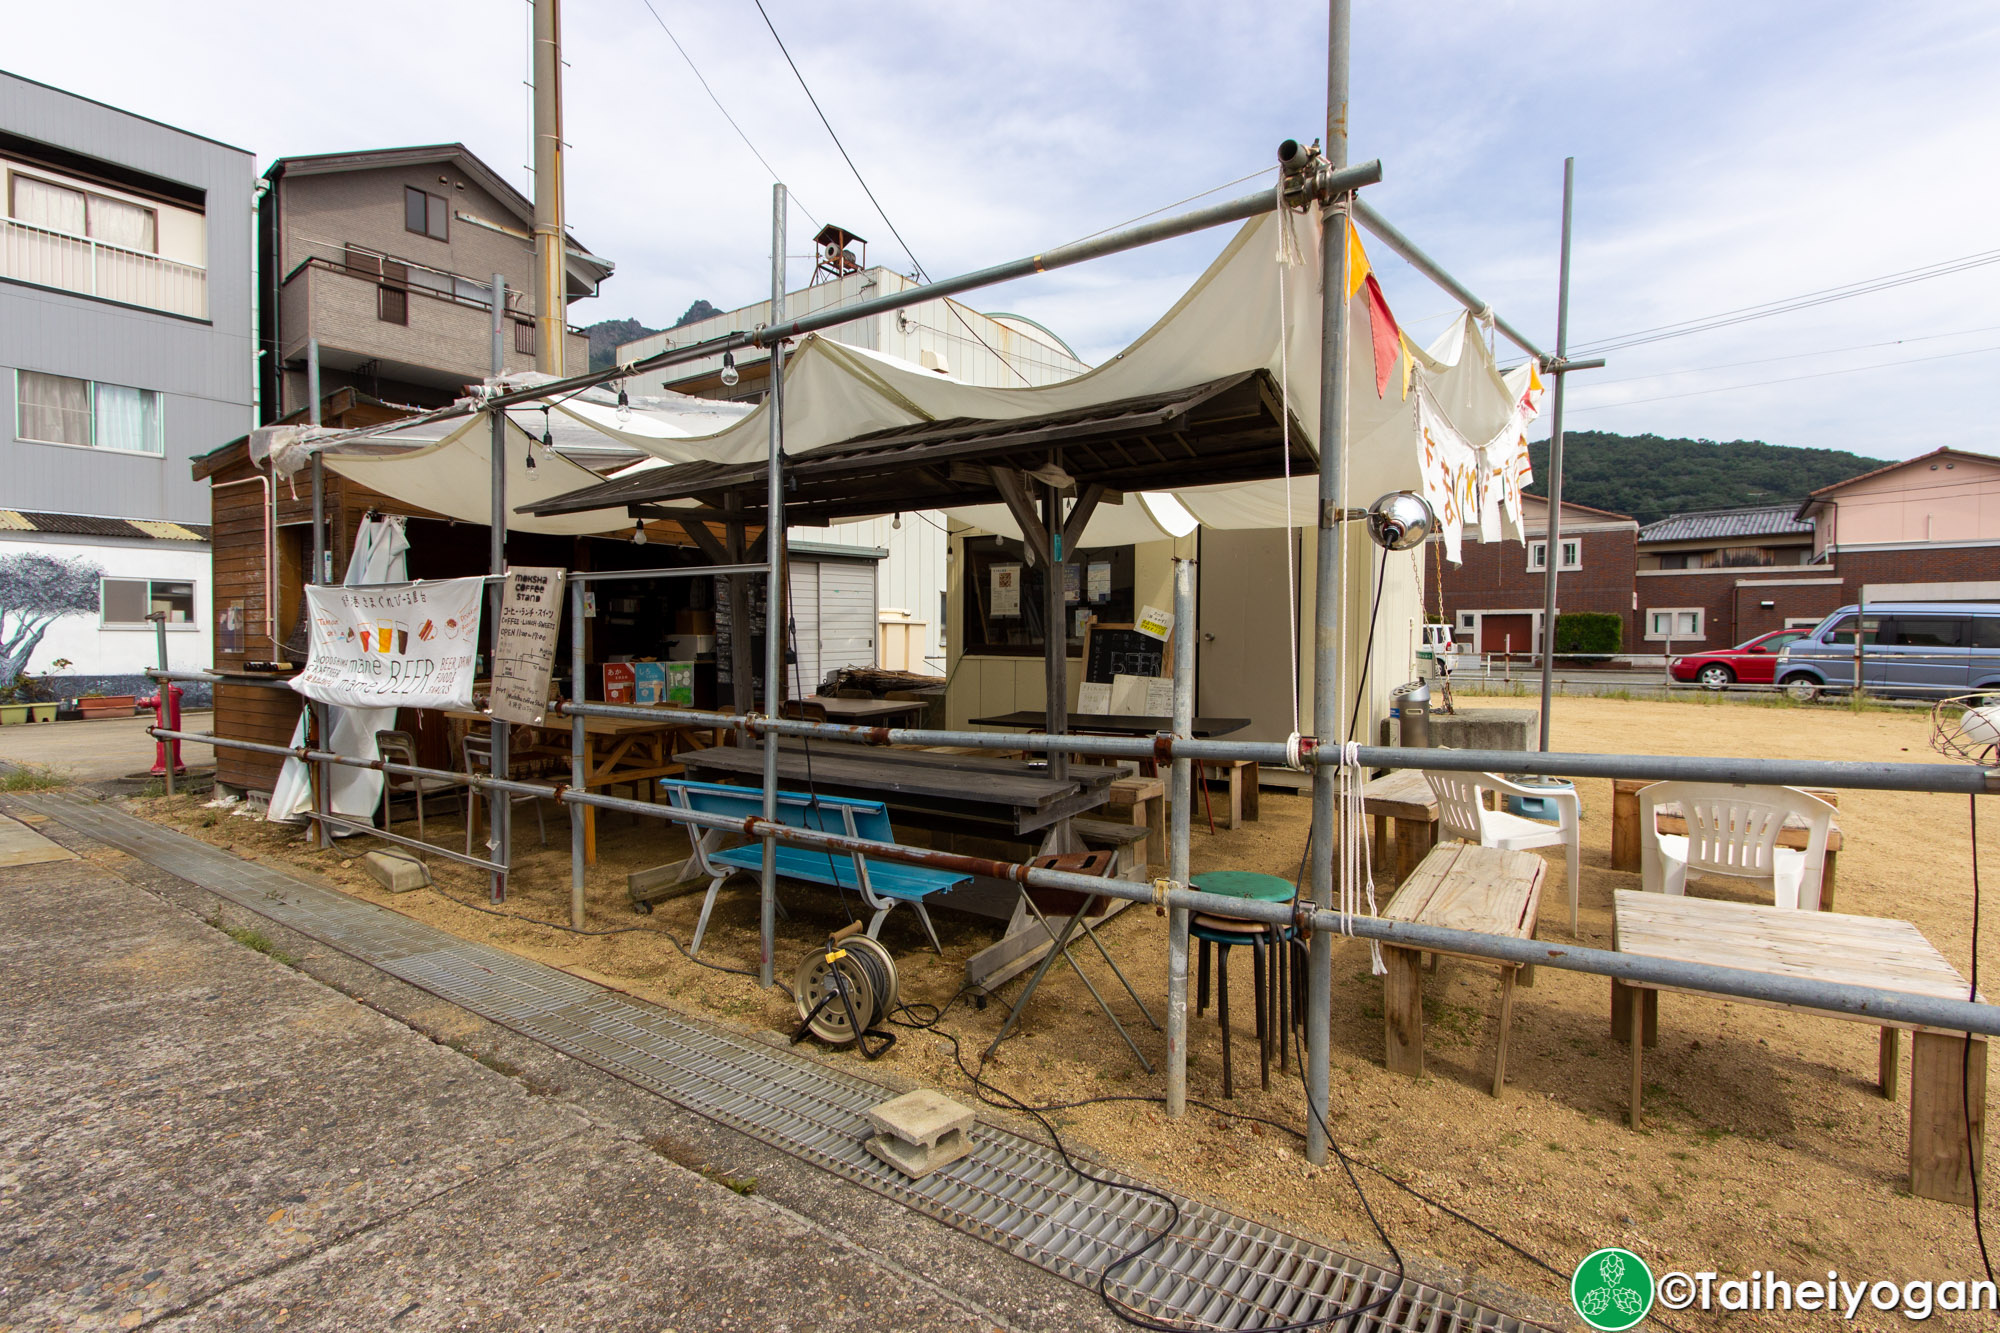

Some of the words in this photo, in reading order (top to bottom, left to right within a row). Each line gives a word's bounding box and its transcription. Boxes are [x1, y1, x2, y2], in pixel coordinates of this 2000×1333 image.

[500, 628, 516, 637] OPEN
[1109, 651, 1161, 677] BEER
[377, 659, 434, 696] BEER
